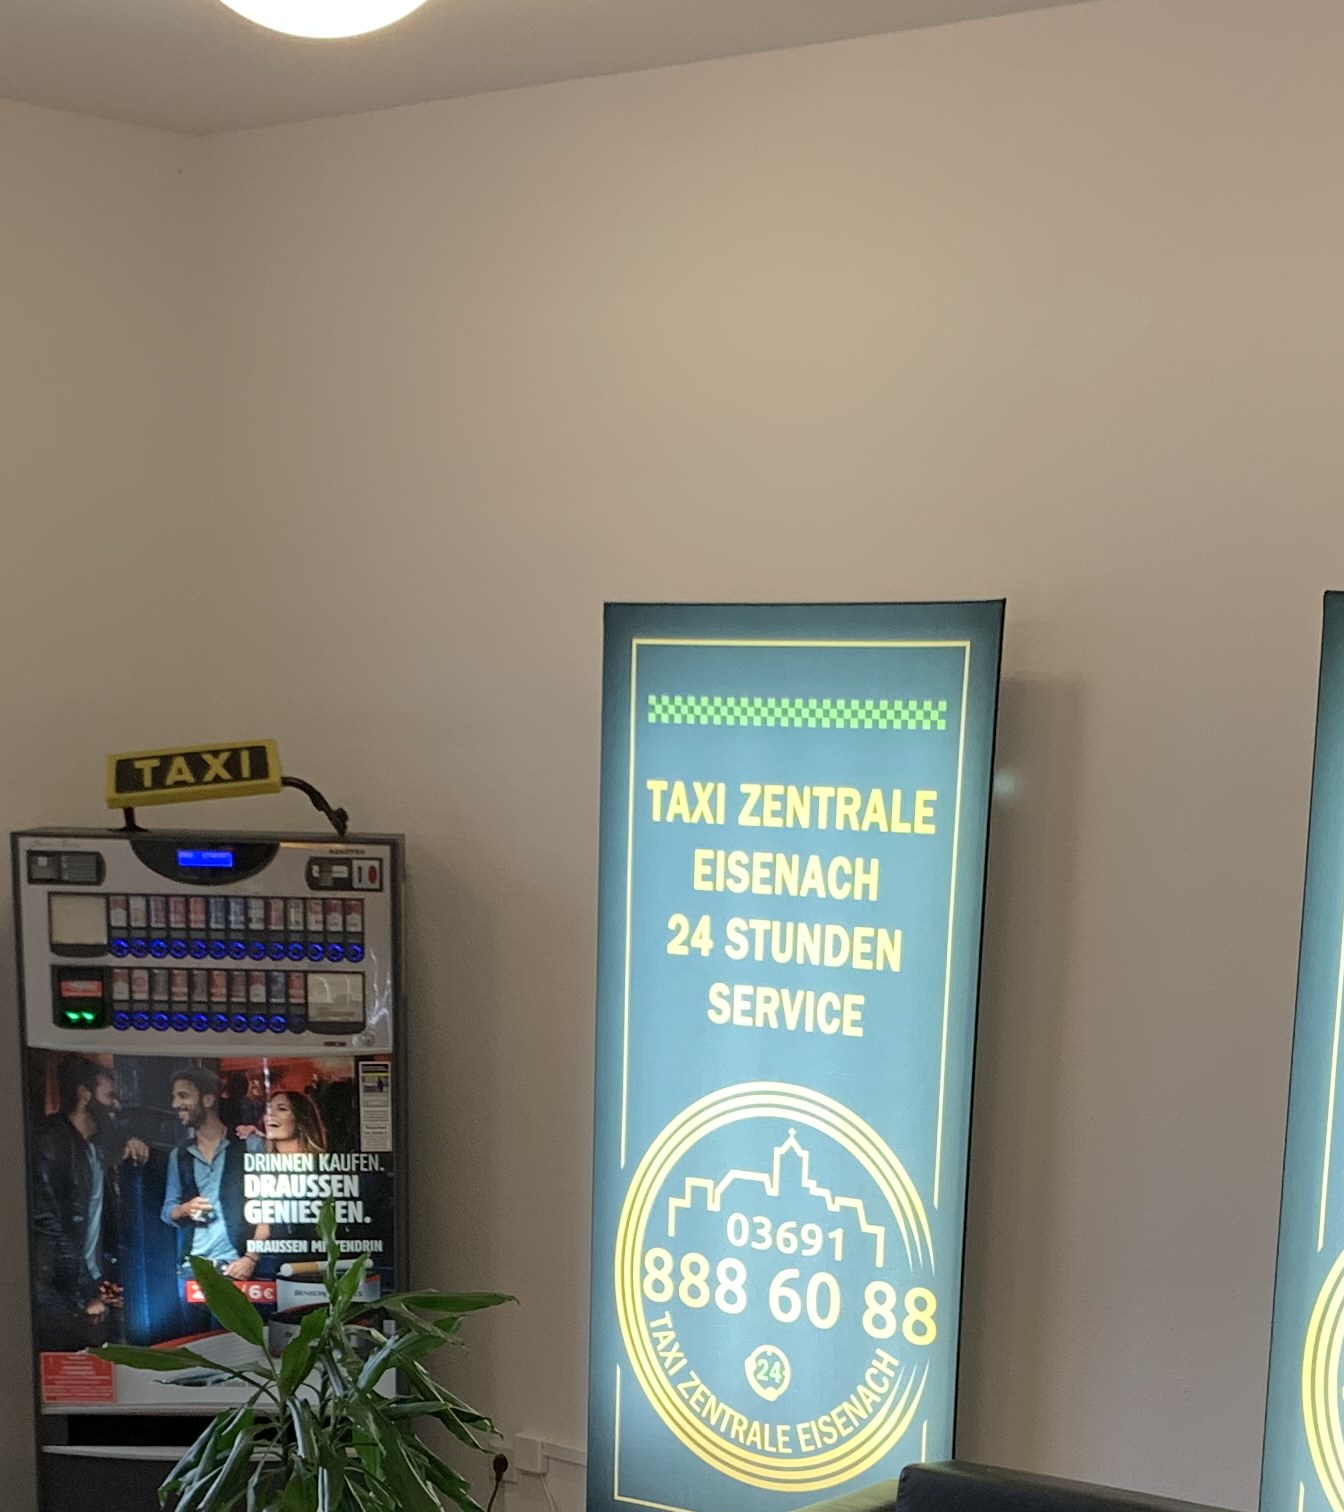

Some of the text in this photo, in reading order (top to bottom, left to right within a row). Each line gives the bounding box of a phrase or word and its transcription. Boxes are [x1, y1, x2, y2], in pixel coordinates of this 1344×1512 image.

[133, 748, 252, 789] TAXI
[646, 780, 938, 834] TAXI ZENTRALE
[693, 848, 880, 901] EISENACH
[666, 913, 902, 972] 24 STUNDEN
[707, 982, 865, 1037] SERVICE
[244, 1153, 385, 1172] DRINNEN KAUFEN.
[244, 1174, 360, 1198] DRAUSSEN
[244, 1200, 372, 1224] GENIESEN.
[726, 1212, 845, 1262] 03691
[246, 1240, 383, 1253] DRAUSSEN MIENDRIN
[642, 1247, 937, 1346] 888 60 88
[649, 1311, 900, 1454] TAXI ZENTRALE EISENACH
[756, 1359, 782, 1384] 24
